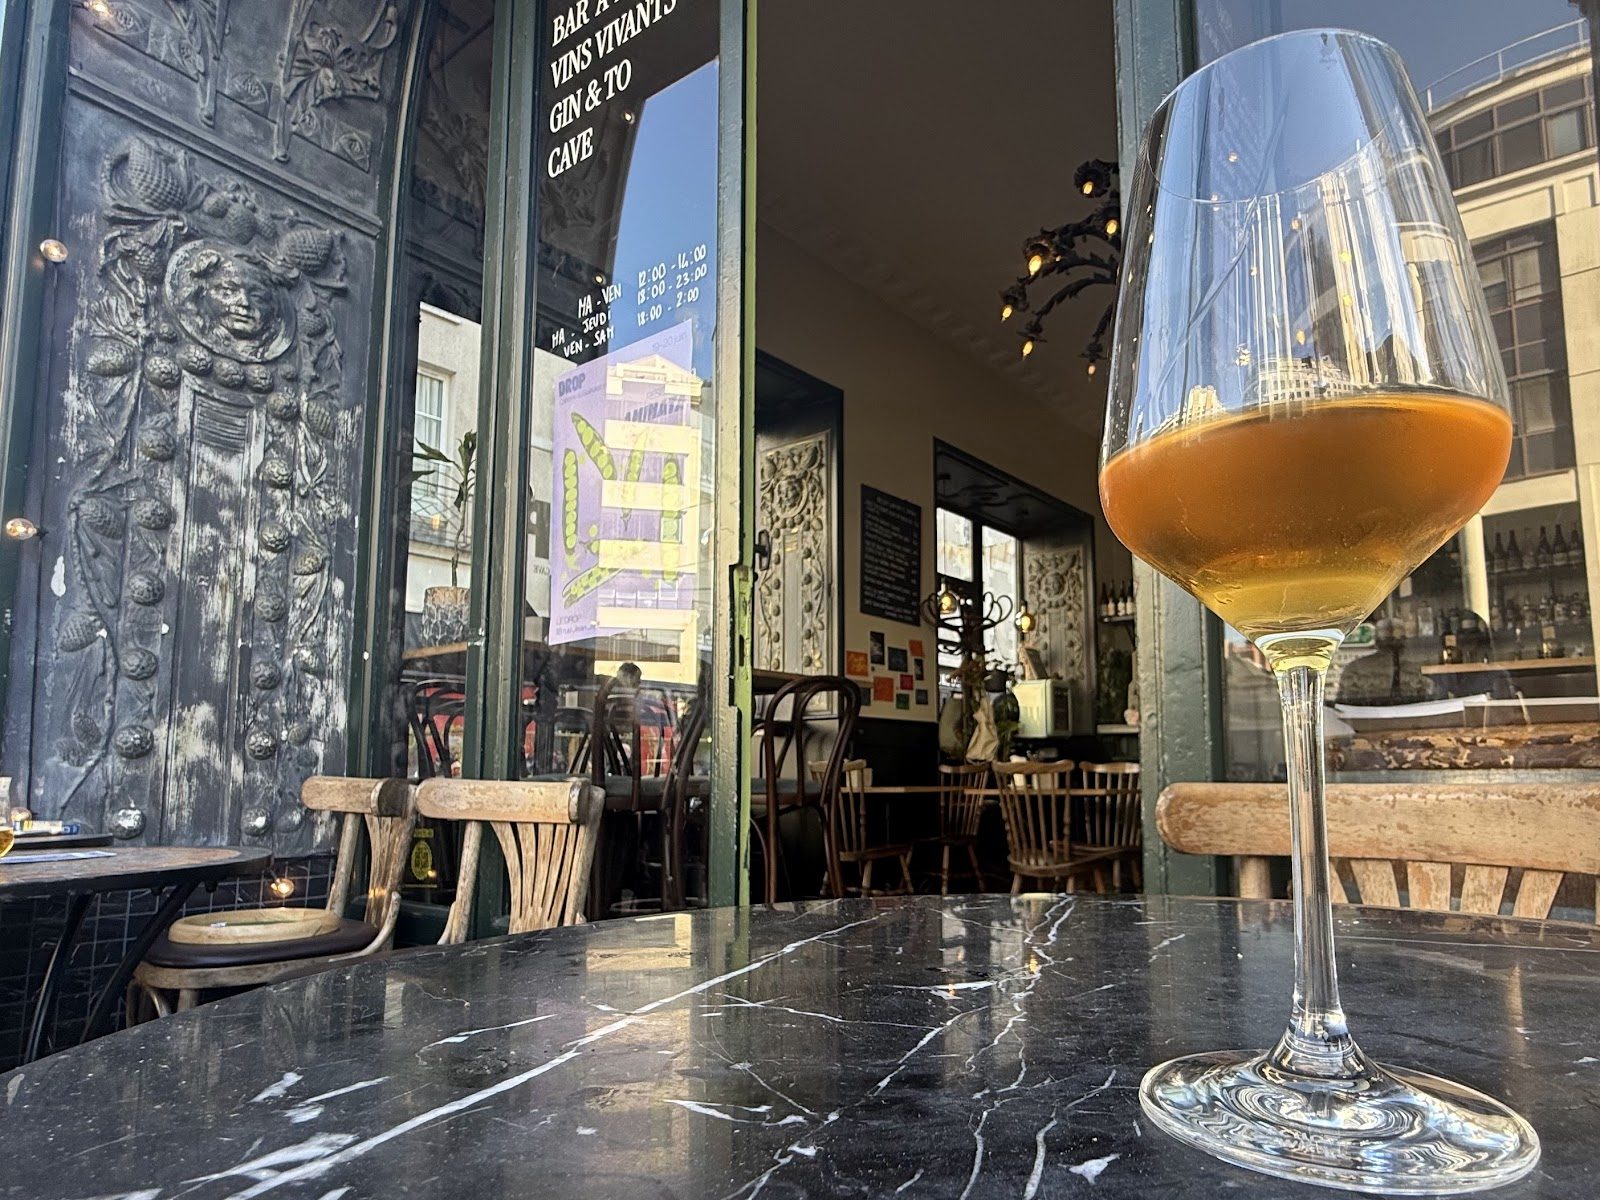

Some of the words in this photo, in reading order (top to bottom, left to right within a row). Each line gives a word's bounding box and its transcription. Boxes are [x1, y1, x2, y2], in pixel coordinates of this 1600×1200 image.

[552, 0, 590, 47] BAR
[551, 38, 592, 88] VINS
[550, 89, 582, 133] GIN
[585, 79, 602, 111] &
[604, 59, 632, 100] TO
[548, 127, 593, 178] CAVE
[602, 283, 622, 304] VEN
[638, 263, 666, 288] 12:00
[676, 263, 707, 289] 23:00
[563, 339, 582, 358] VEN
[637, 305, 662, 327] 18:00
[676, 287, 699, 308] 2:00
[559, 373, 586, 397] DROP
